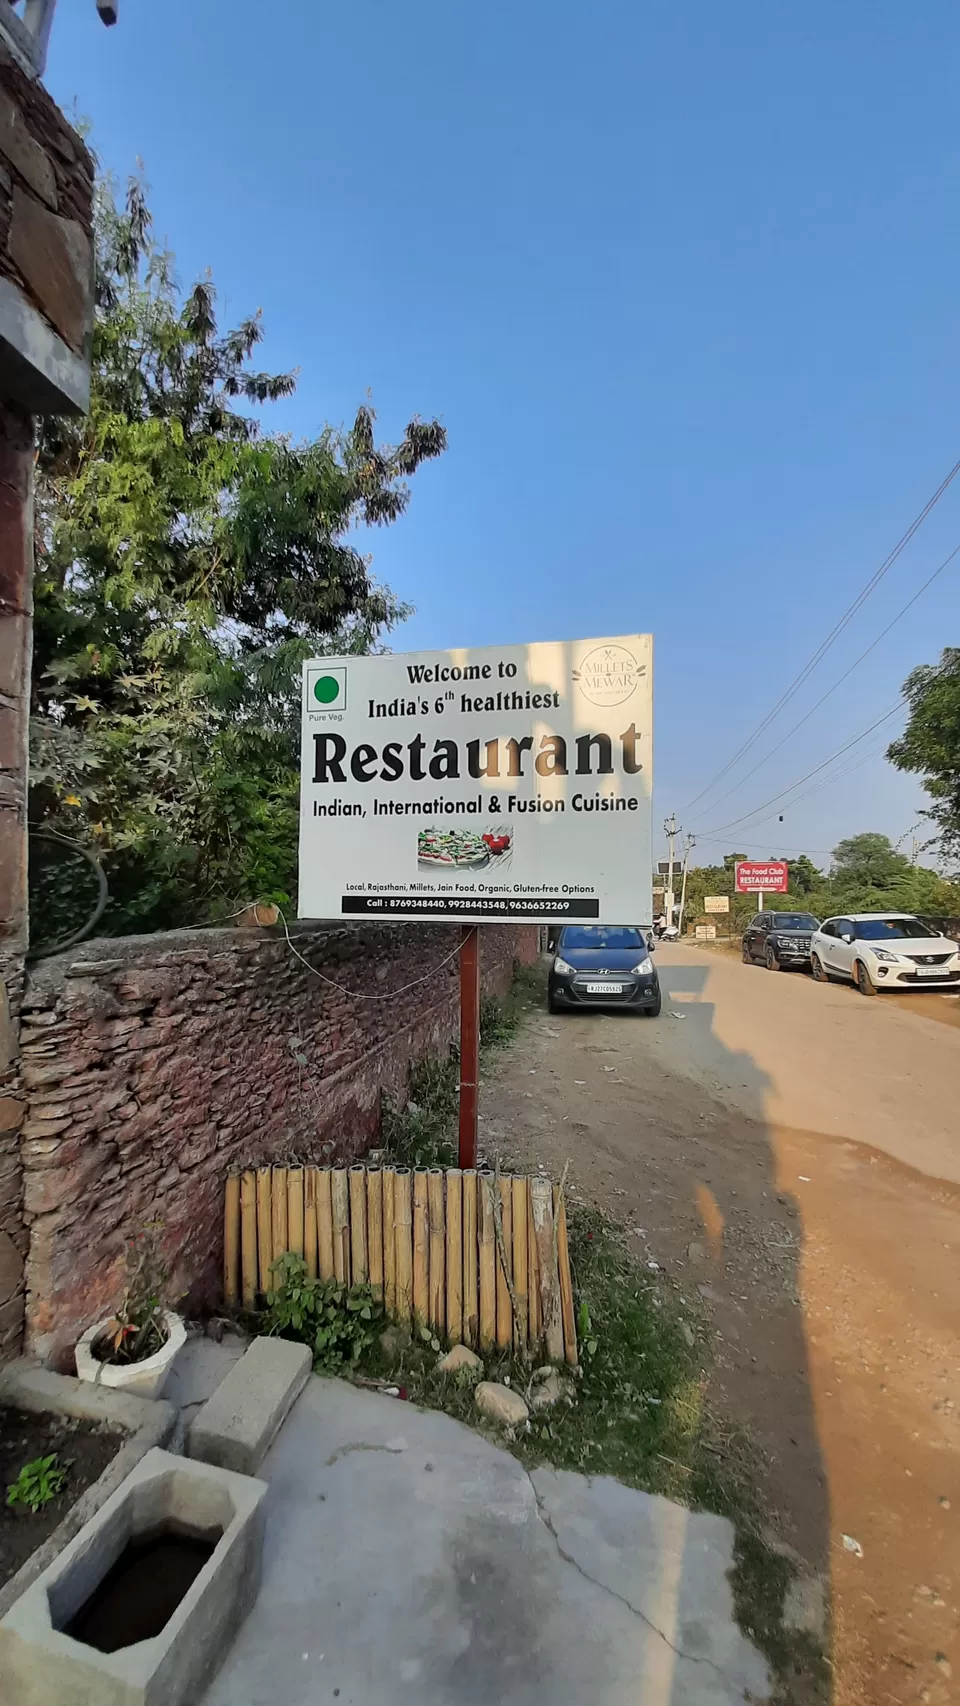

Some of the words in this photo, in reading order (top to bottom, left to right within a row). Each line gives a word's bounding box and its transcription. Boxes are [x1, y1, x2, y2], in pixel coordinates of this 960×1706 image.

[406, 663, 492, 684] Welcome
[497, 661, 518, 678] to
[585, 659, 634, 674] MILLETS
[584, 674, 634, 688] MEWAR
[368, 696, 429, 718] India's
[460, 690, 560, 713] healthiest
[308, 714, 327, 722] Pure
[328, 713, 345, 722] Veg.
[312, 723, 643, 783] Restaurant
[313, 799, 367, 818] Indian,
[373, 794, 482, 815] International
[488, 795, 502, 813] &
[508, 793, 565, 813] Fusion
[571, 792, 639, 812] Cuisine
[740, 876, 784, 884] RESTAURANT
[346, 883, 366, 892] Local,
[367, 883, 408, 893] Rajasthani,
[409, 883, 436, 892] Millets,
[437, 883, 453, 892] Jain
[455, 883, 477, 893] Food,
[478, 884, 512, 894] Organic,
[513, 884, 559, 893] Gluten-free
[561, 884, 595, 895] Options
[366, 899, 383, 907] Call
[509, 901, 570, 910] 9636652269
